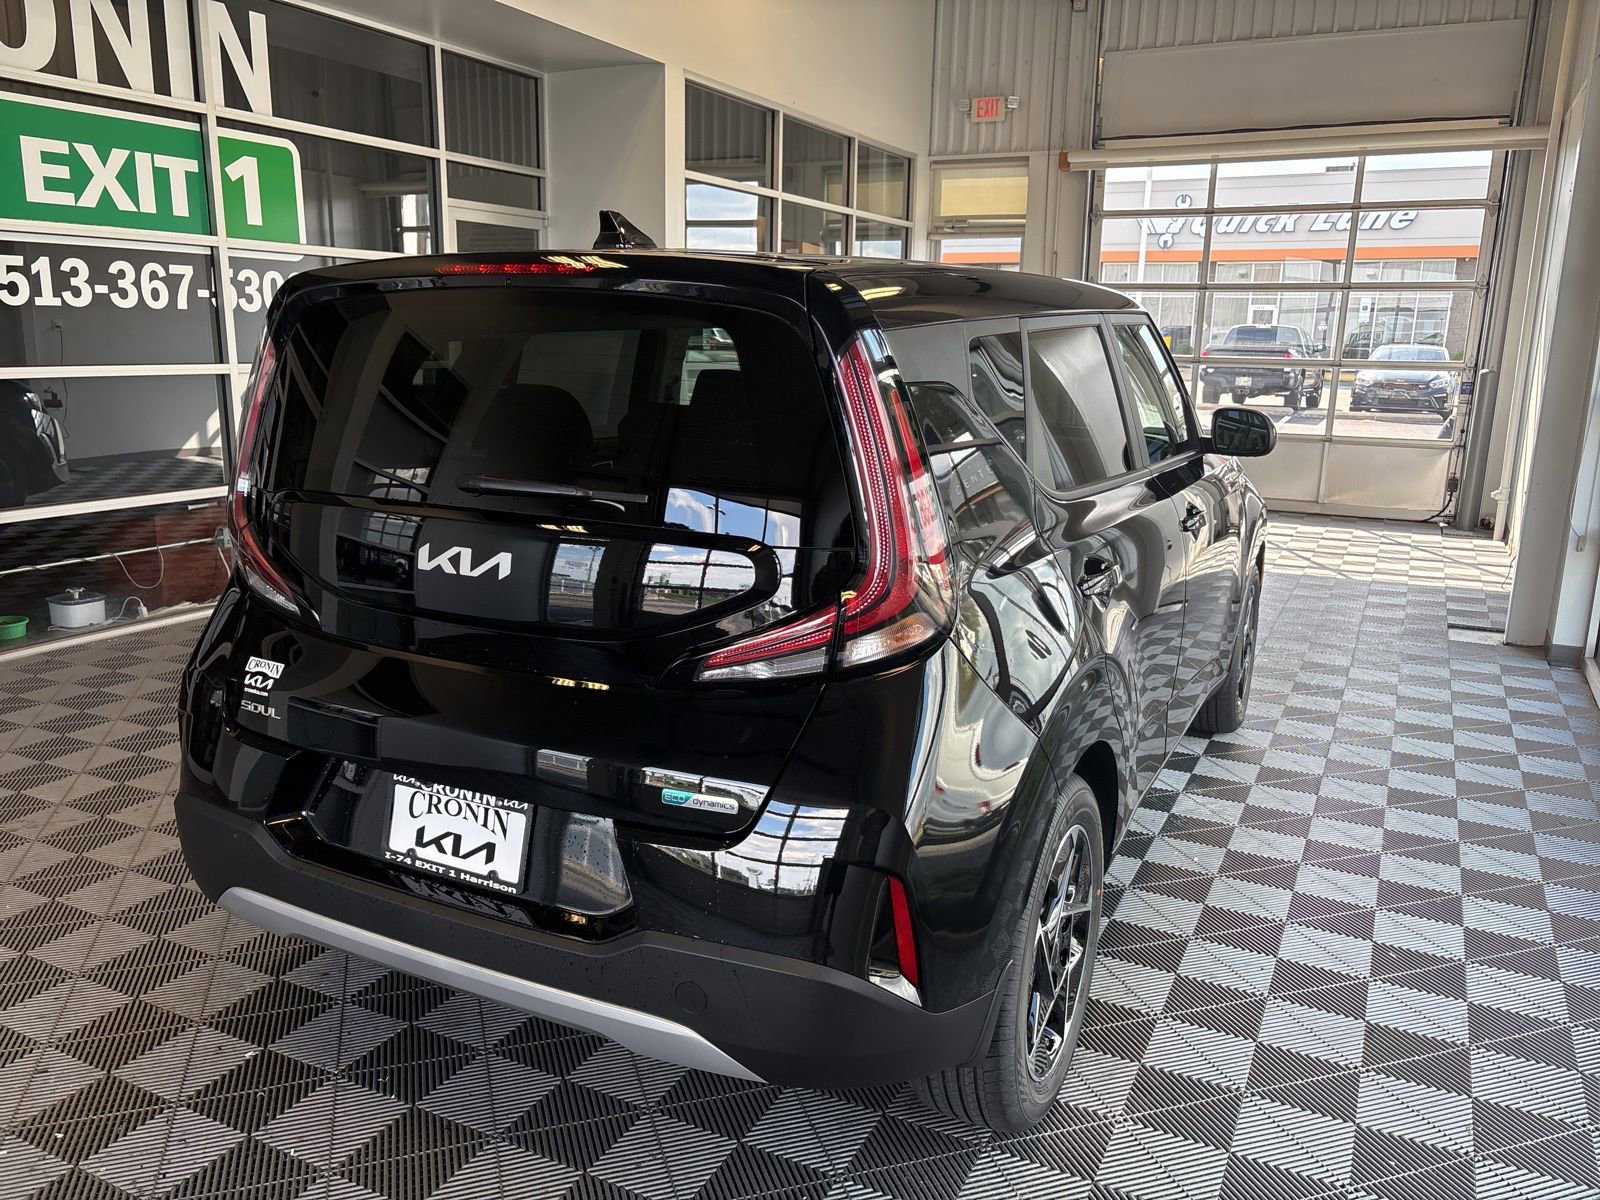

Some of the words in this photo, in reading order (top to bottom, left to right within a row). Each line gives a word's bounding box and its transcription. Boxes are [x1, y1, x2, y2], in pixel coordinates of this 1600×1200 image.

[976, 96, 1001, 118] EXIT
[19, 135, 199, 217] EXIT
[224, 155, 263, 226] 1
[1190, 206, 1302, 238] Quick
[1308, 206, 1419, 233] Lane
[0, 254, 299, 312] 513-367-530
[417, 542, 512, 580] KIA
[243, 673, 275, 690] KIA
[248, 658, 282, 677] CRONIN
[240, 699, 281, 720] SOUL
[393, 773, 415, 787] KIA
[503, 798, 528, 811] KIA
[664, 792, 686, 803] ECO
[692, 797, 735, 810] dynamics
[408, 790, 512, 842] CRONIN
[414, 824, 497, 866] KIA
[384, 850, 412, 866] I-74
[415, 859, 446, 874] EXIT
[448, 868, 456, 878] 1
[460, 872, 517, 895] Harrison
